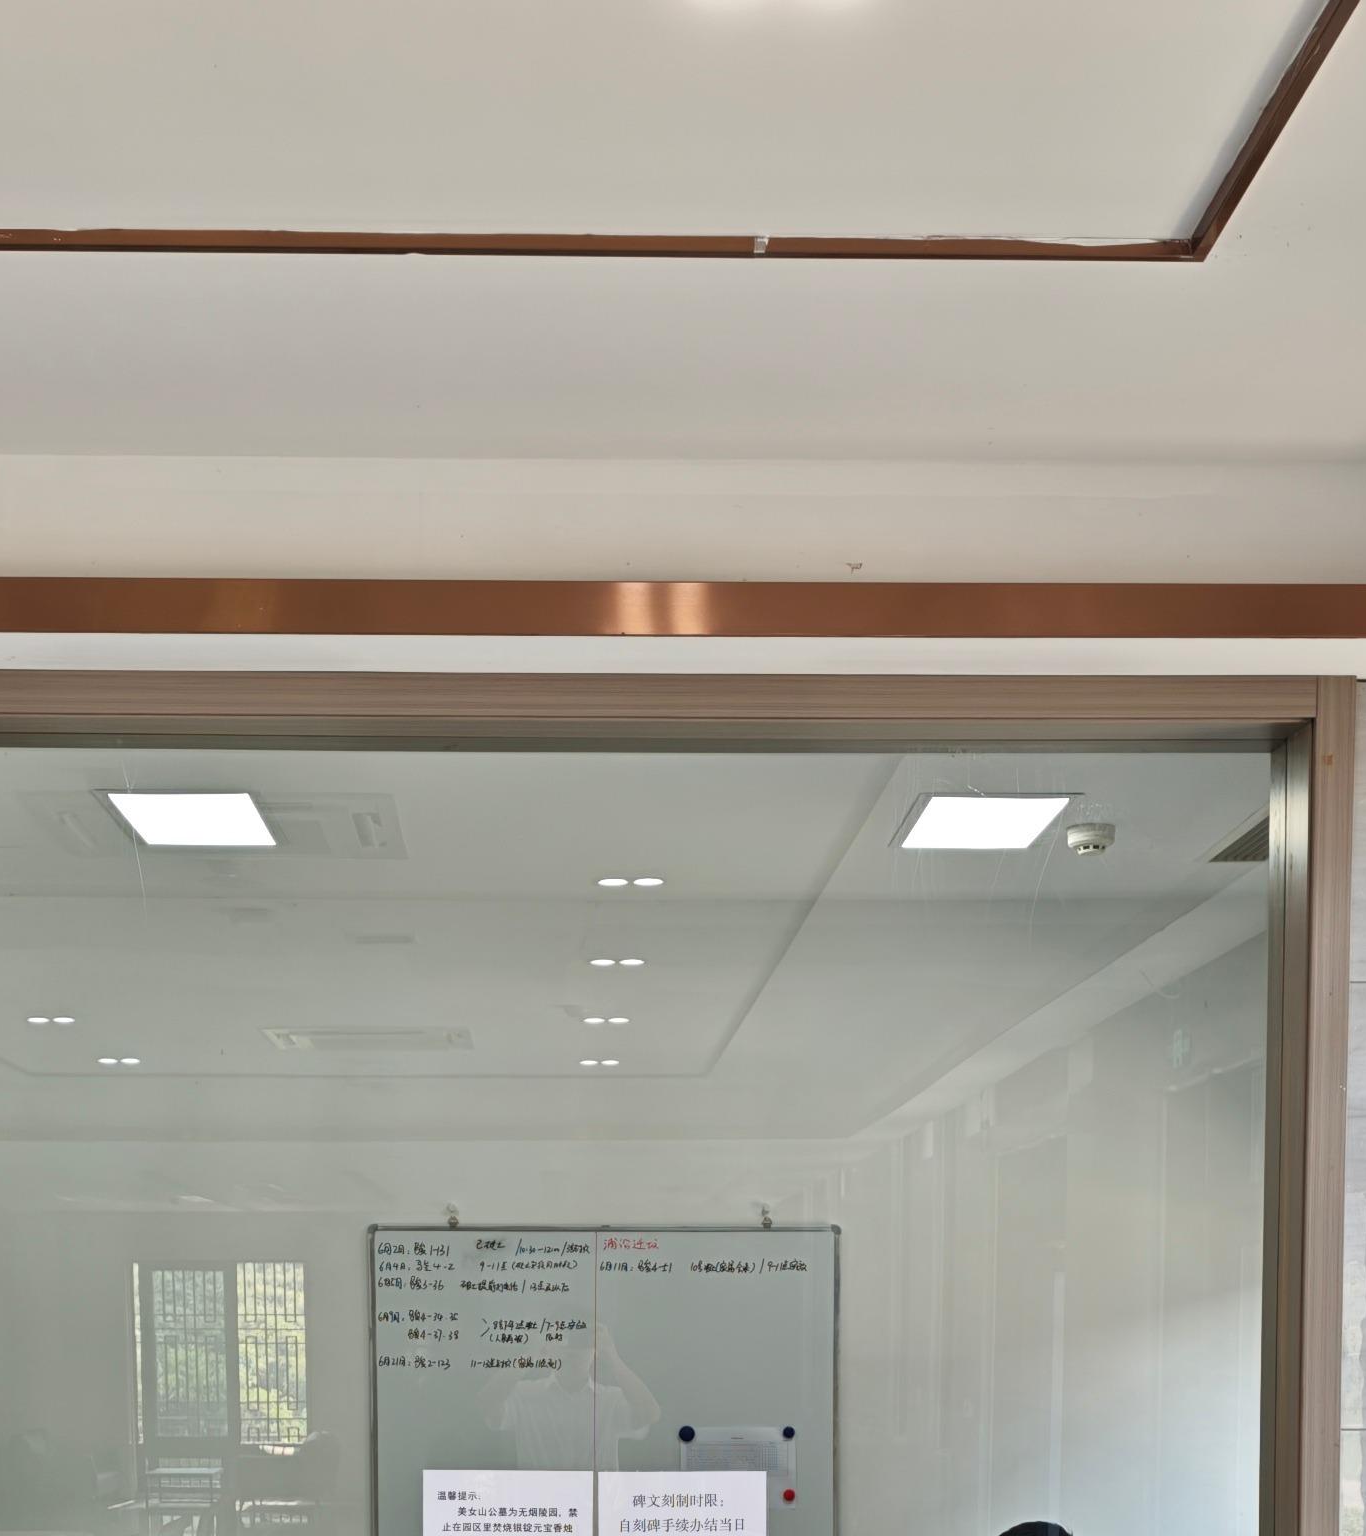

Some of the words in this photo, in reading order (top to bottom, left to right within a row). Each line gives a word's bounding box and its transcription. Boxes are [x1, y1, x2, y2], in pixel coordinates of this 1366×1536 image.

[620, 1517, 746, 1533] 自刻碑手续办结当日
